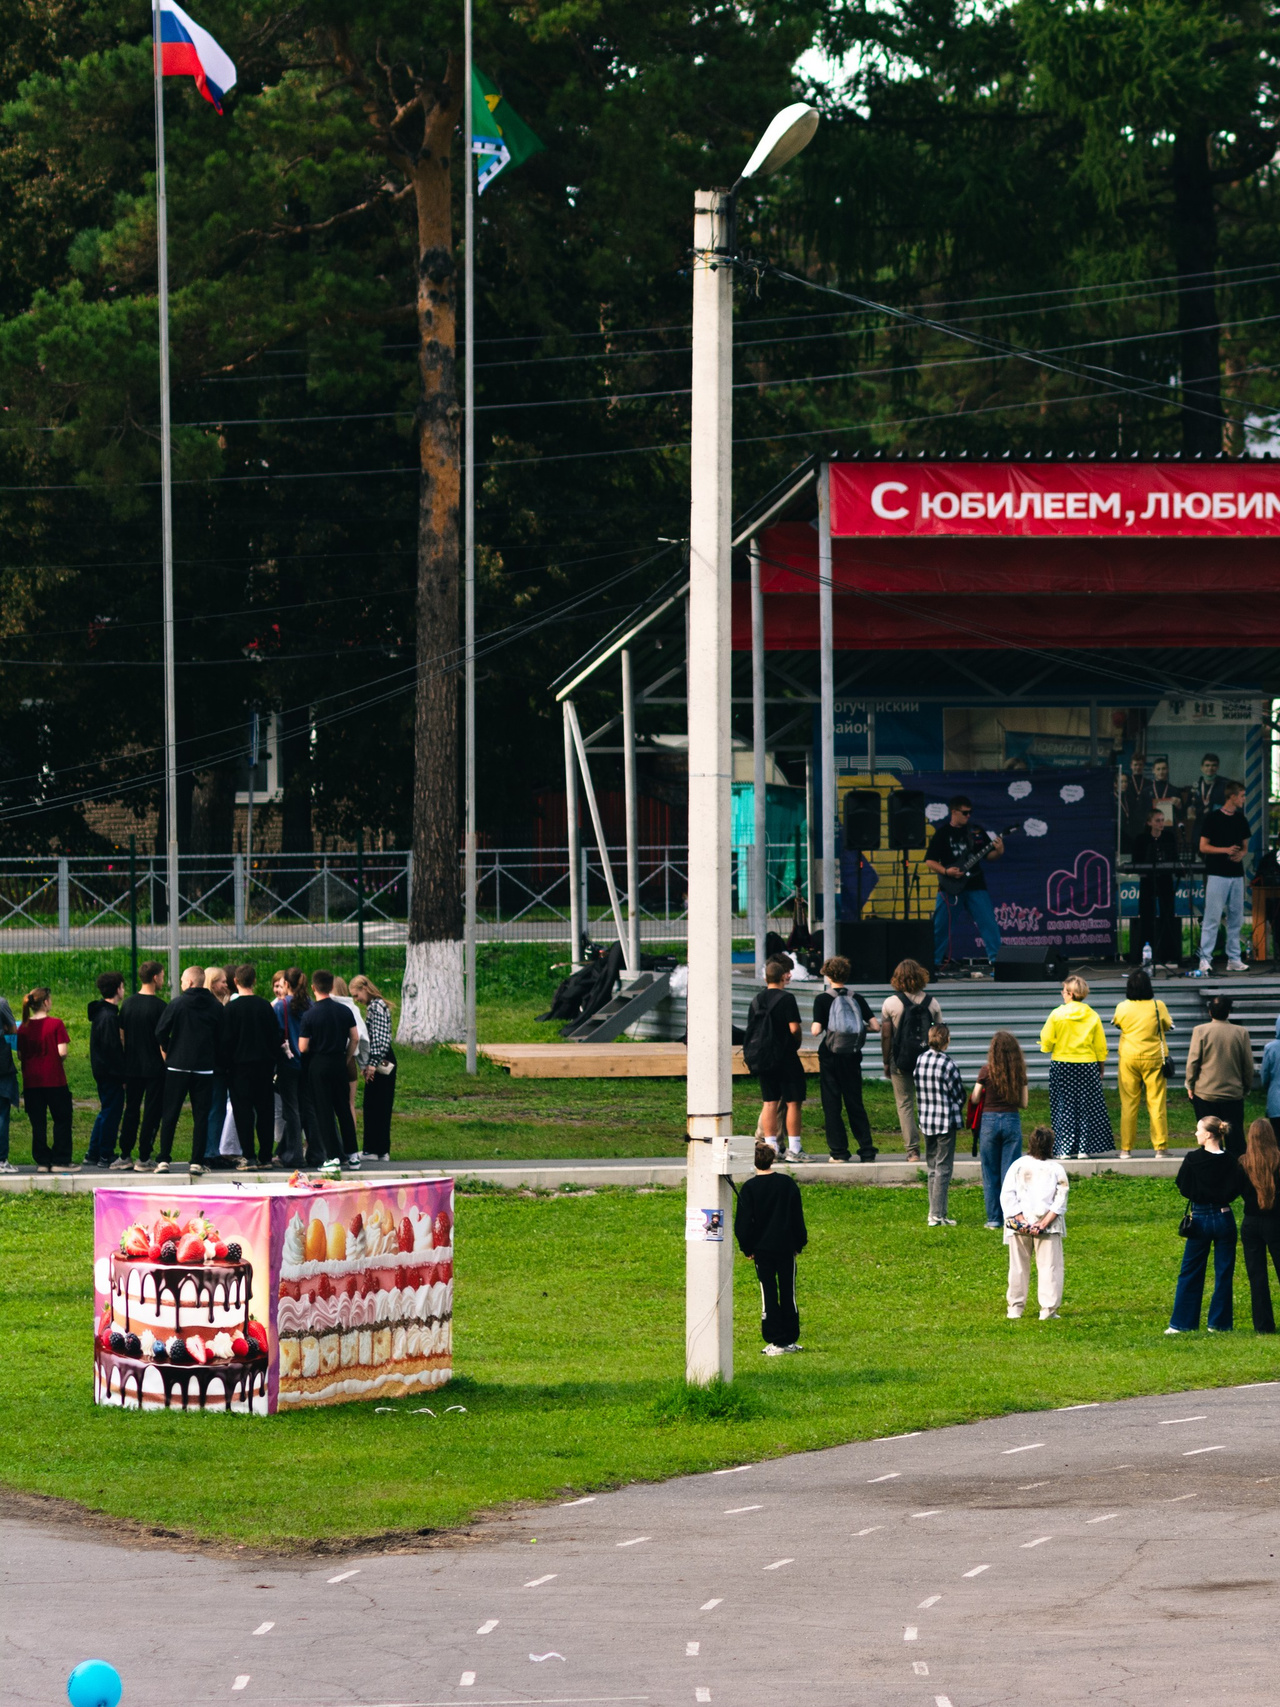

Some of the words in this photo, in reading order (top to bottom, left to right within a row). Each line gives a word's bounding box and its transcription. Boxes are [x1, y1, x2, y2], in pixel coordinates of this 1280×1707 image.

[870, 480, 909, 520] С
[921, 491, 1135, 526] ЮБИЛЕЕМ,
[833, 720, 869, 734] айон
